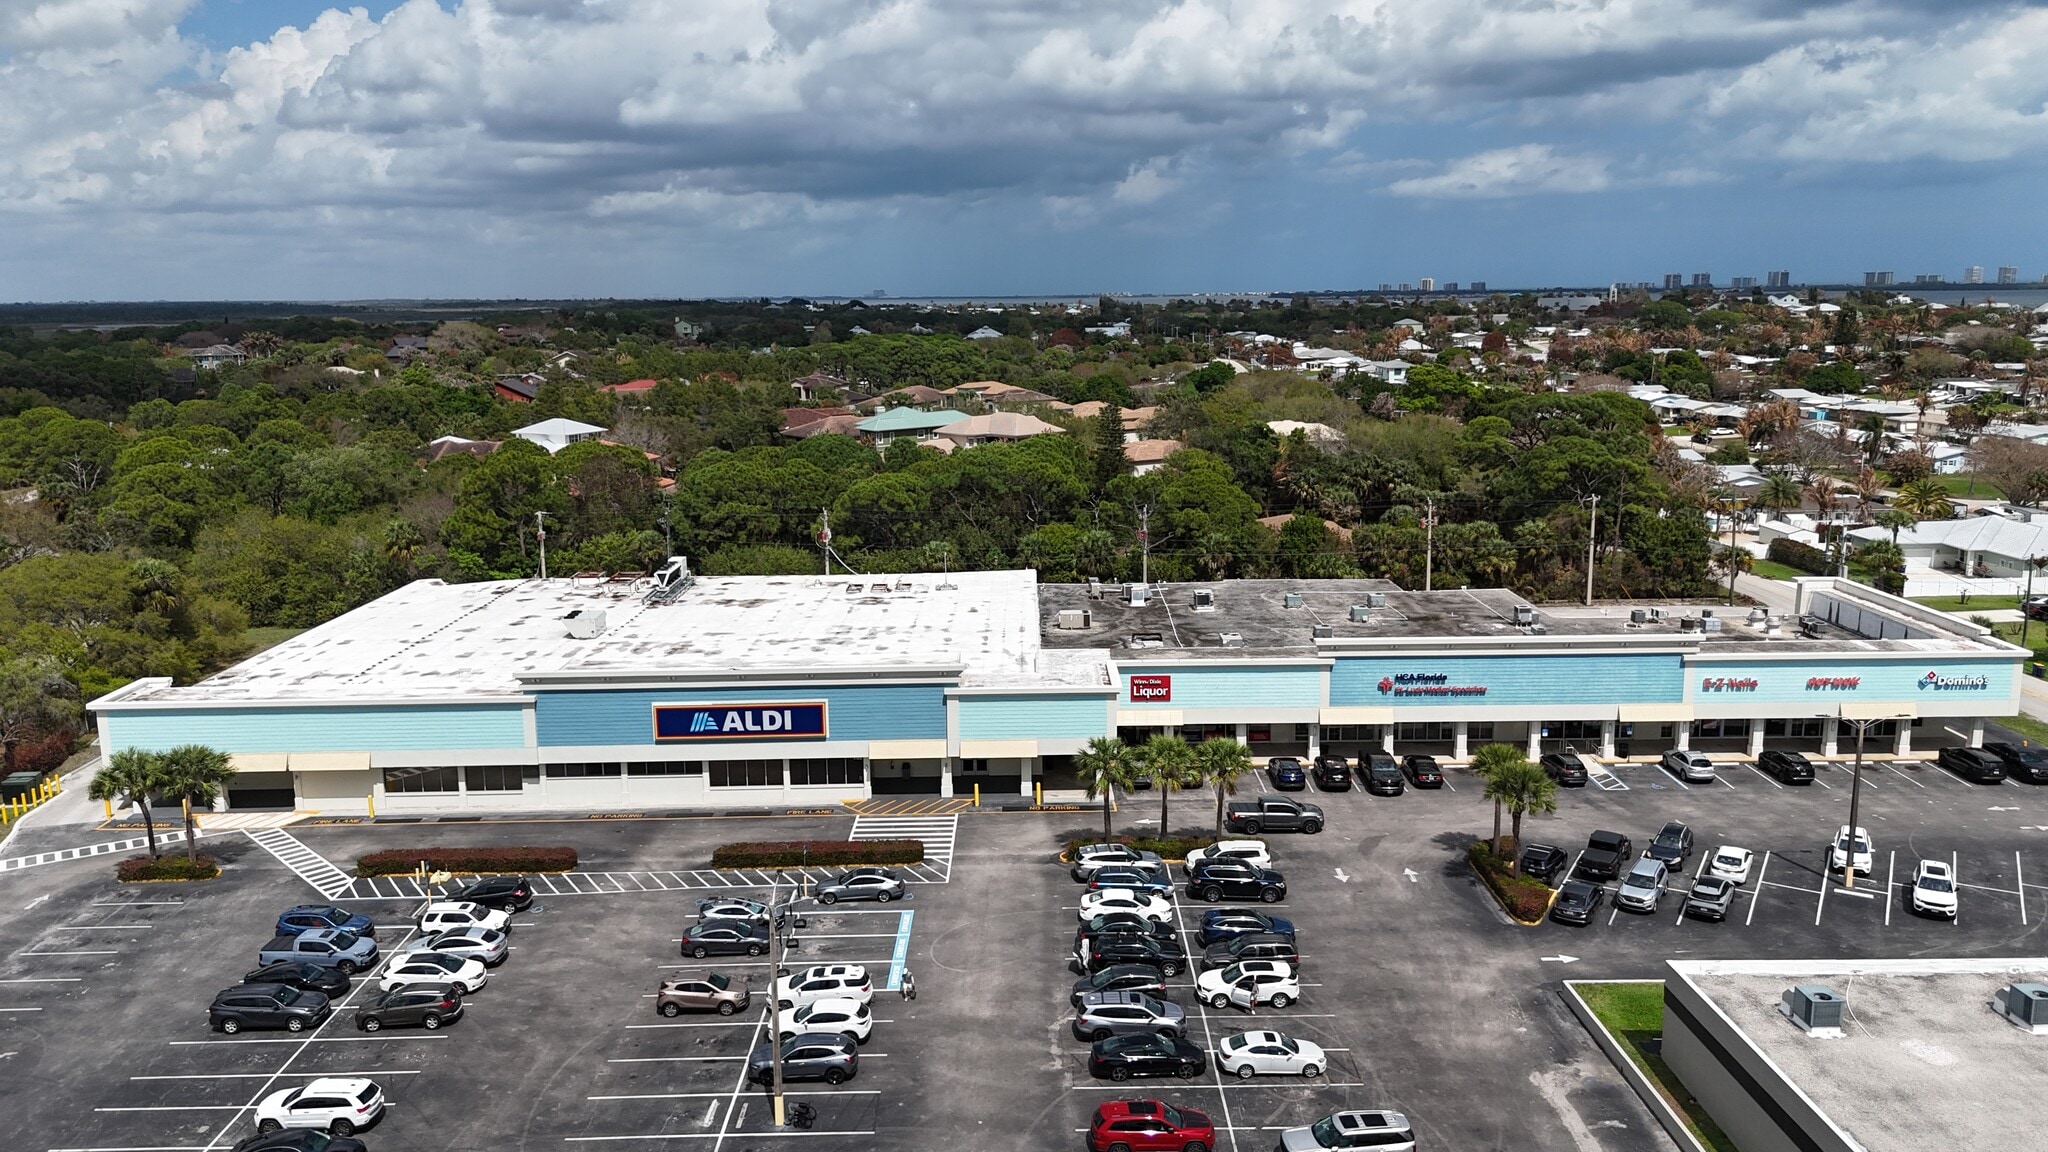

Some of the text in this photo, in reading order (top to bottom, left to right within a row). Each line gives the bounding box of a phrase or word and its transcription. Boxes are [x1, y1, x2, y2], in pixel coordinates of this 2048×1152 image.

[1417, 673, 1447, 681] Florida
[1728, 677, 1758, 688] Nails
[1936, 674, 1990, 686] Domino's
[1133, 685, 1169, 699] Liquor
[722, 709, 793, 732] ALDI
